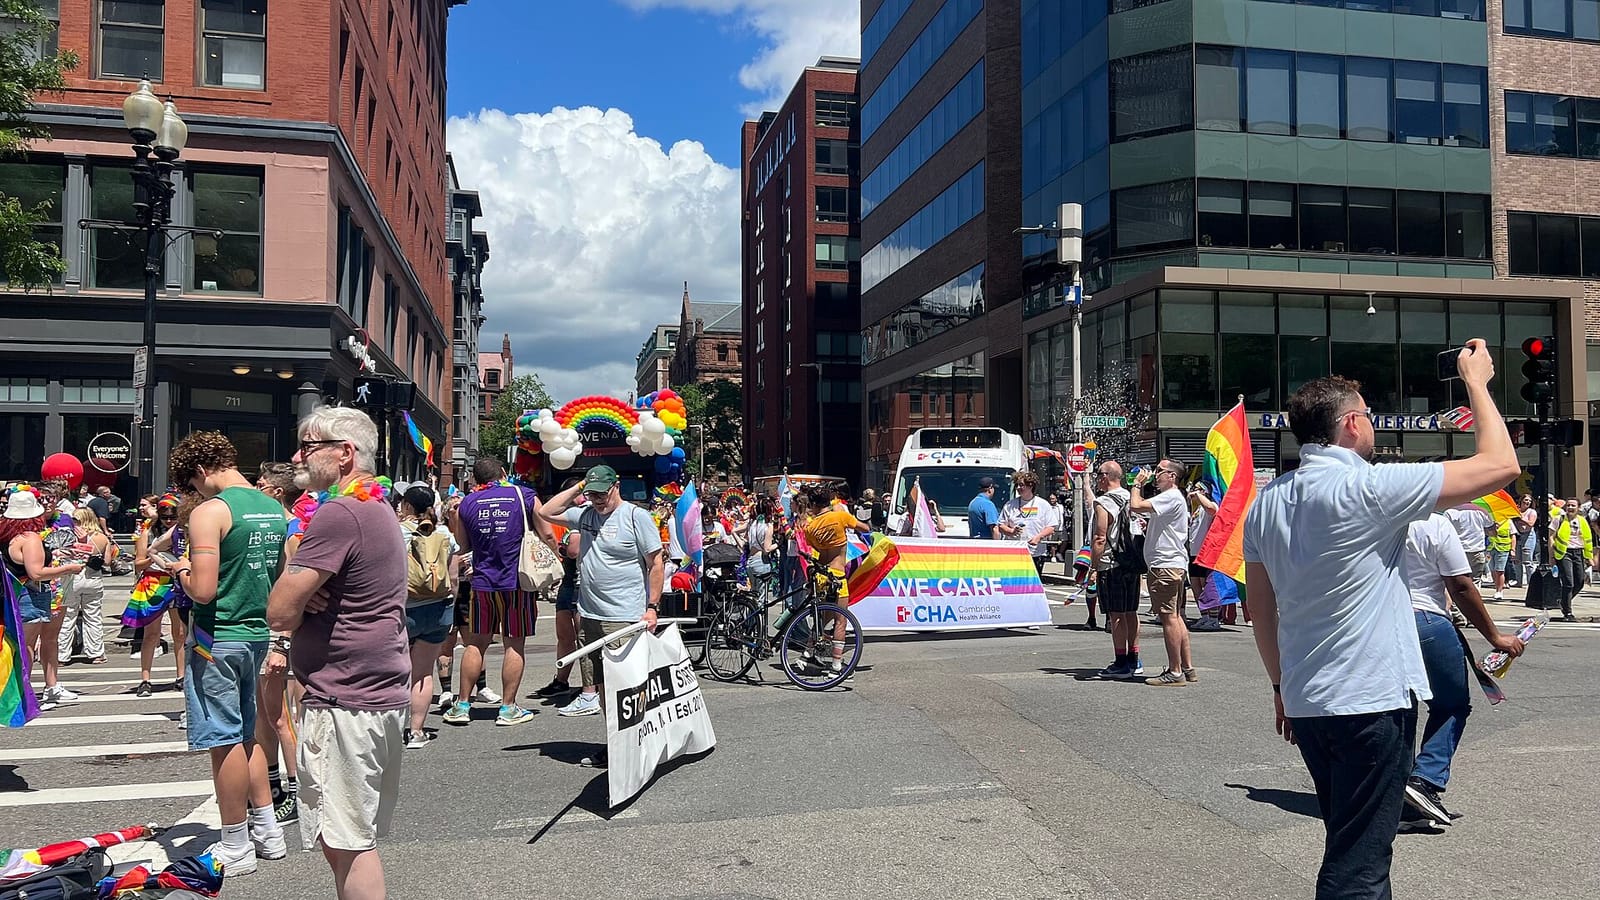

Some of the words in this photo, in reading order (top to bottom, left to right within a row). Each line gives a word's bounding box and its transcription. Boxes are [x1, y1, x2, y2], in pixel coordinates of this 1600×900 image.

[225, 396, 240, 406] 711
[1082, 417, 1118, 426] BOYLSTON
[1262, 413, 1288, 427] BA
[1373, 415, 1439, 430] MERICA
[93, 445, 129, 455] Everyone's
[931, 451, 965, 459] CHA
[887, 577, 932, 597] WE
[937, 577, 1005, 597] CARE
[914, 605, 957, 623] CHA
[958, 605, 1001, 614] Cambridge
[979, 613, 1001, 621] Alliance
